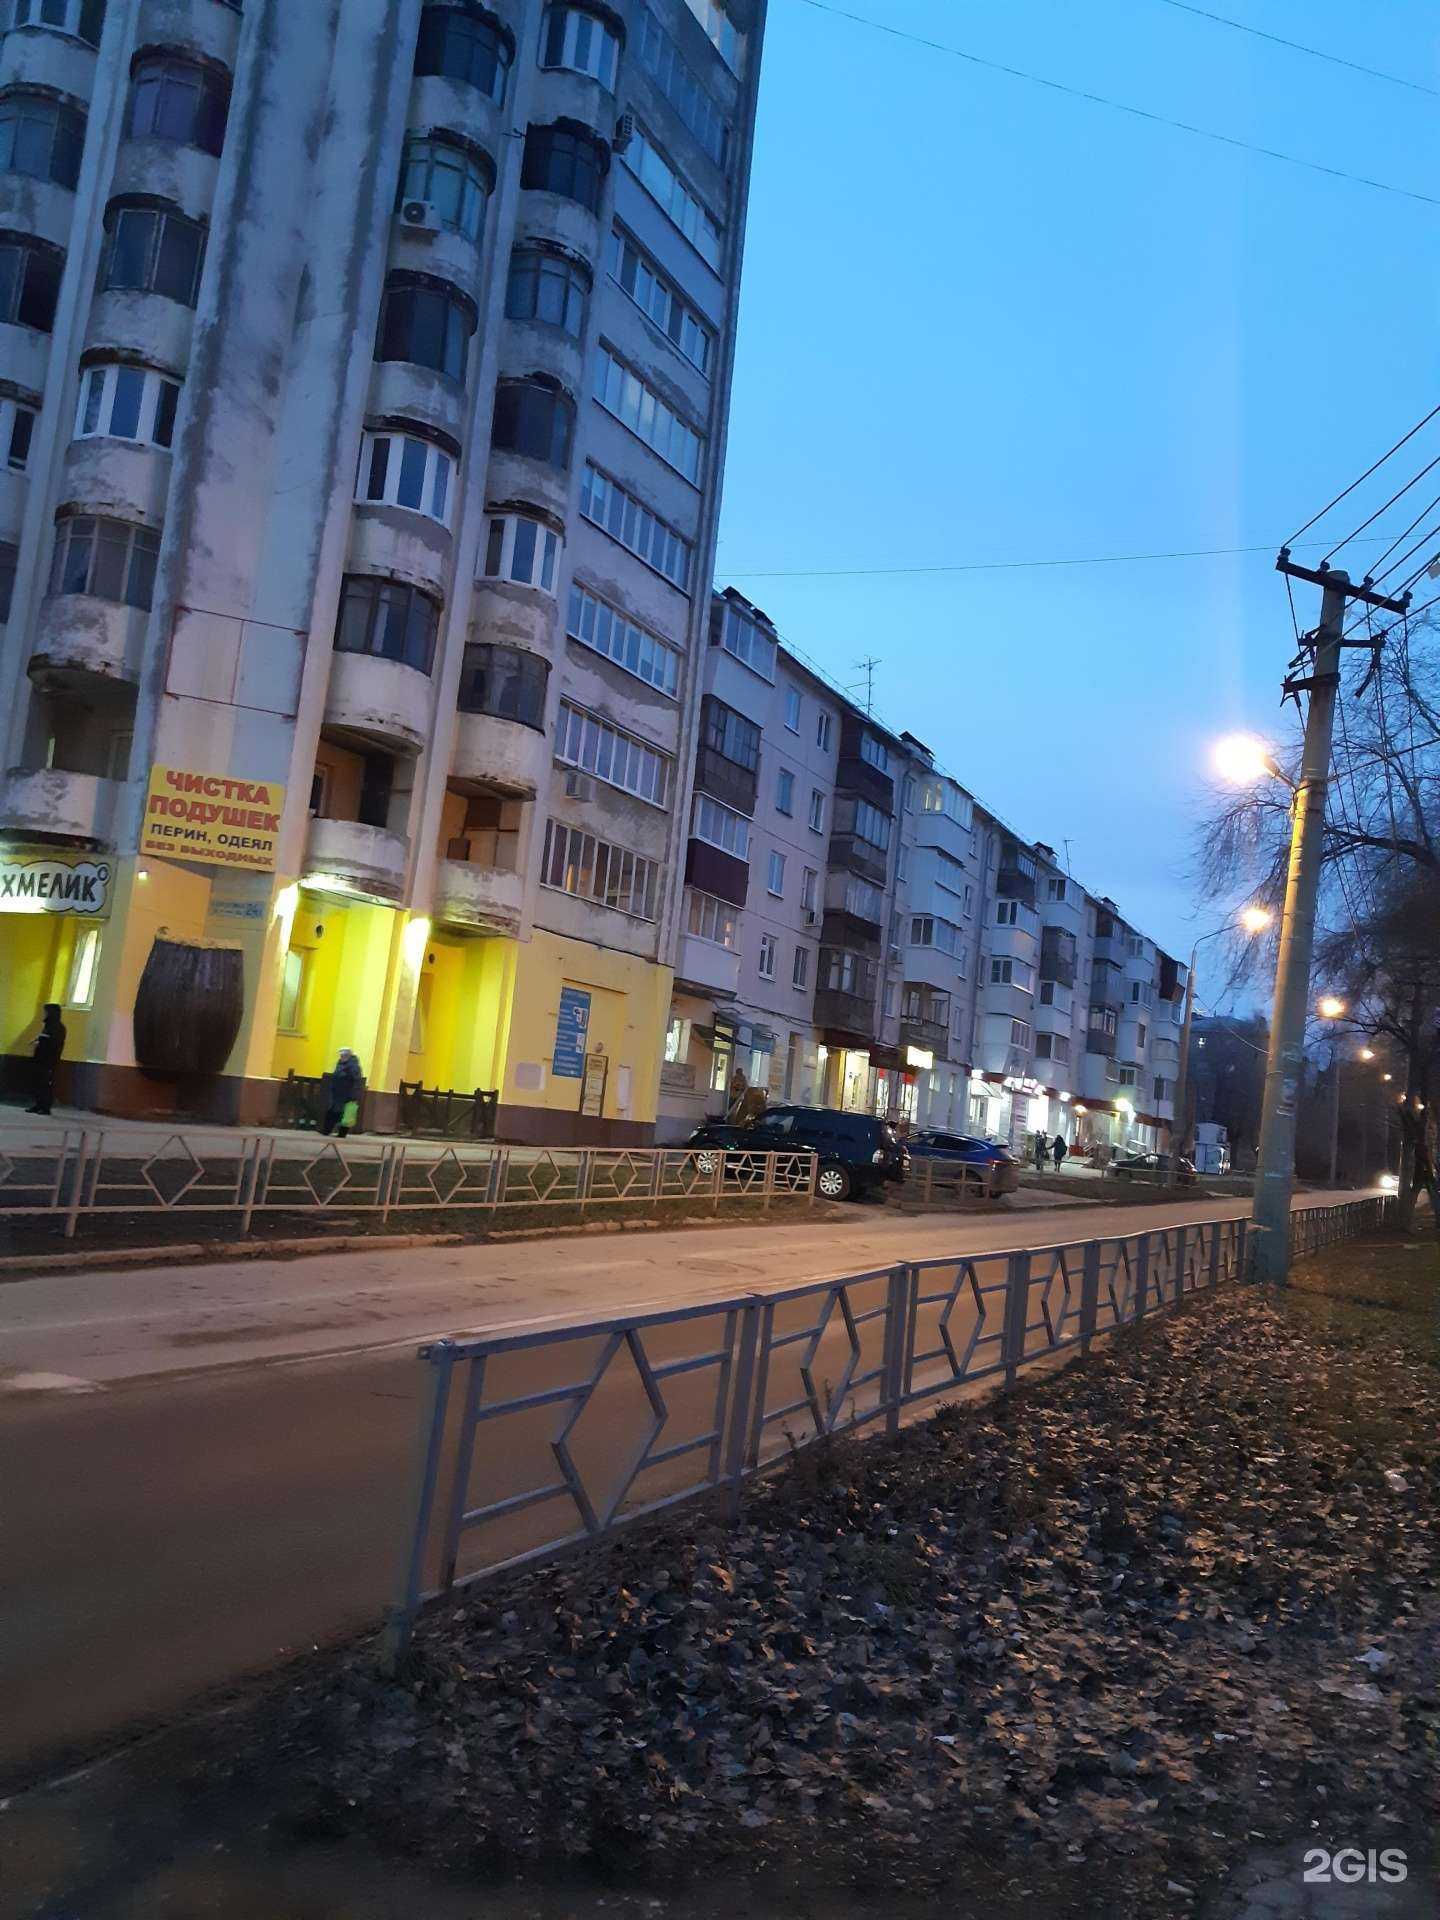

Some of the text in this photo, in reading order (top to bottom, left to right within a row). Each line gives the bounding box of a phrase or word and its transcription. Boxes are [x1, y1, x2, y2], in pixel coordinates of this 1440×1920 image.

[166, 770, 270, 805] ЧИСТКА
[149, 795, 280, 832] ПОДУШЕК
[151, 823, 273, 851] ПЕРИН, ОДЕЯЛ
[180, 844, 273, 865] ВЫХОДНЫХ
[1, 872, 97, 902] ХМЕЛИК
